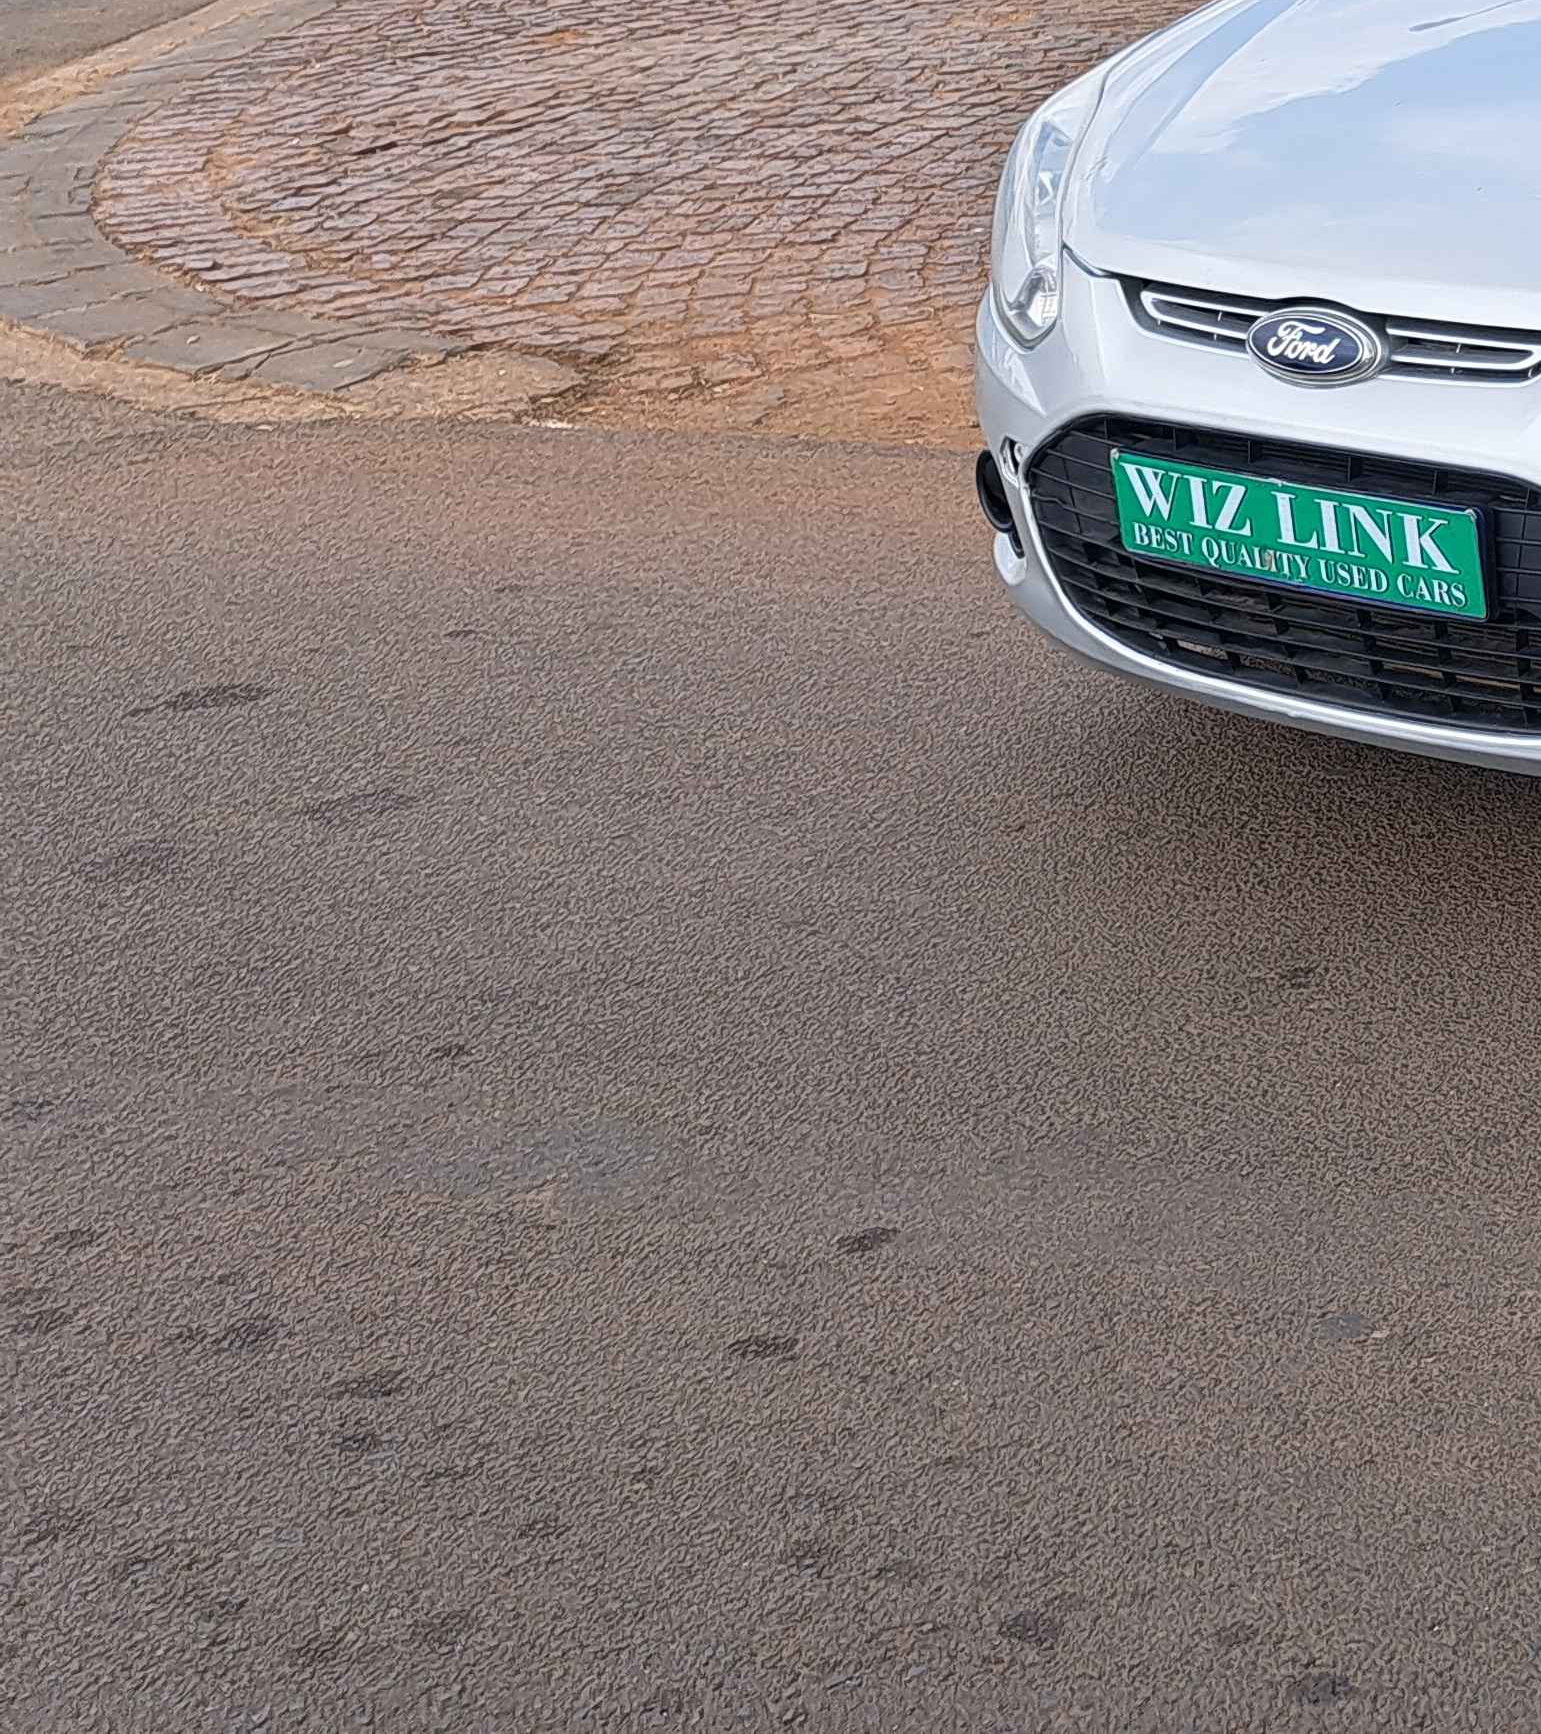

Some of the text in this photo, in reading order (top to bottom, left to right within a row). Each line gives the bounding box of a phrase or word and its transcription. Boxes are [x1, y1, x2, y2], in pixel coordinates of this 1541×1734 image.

[1265, 320, 1342, 365] Ford
[1121, 462, 1460, 575] WIZ LINK
[1132, 521, 1468, 610] BEST QUALITY USED CARS
